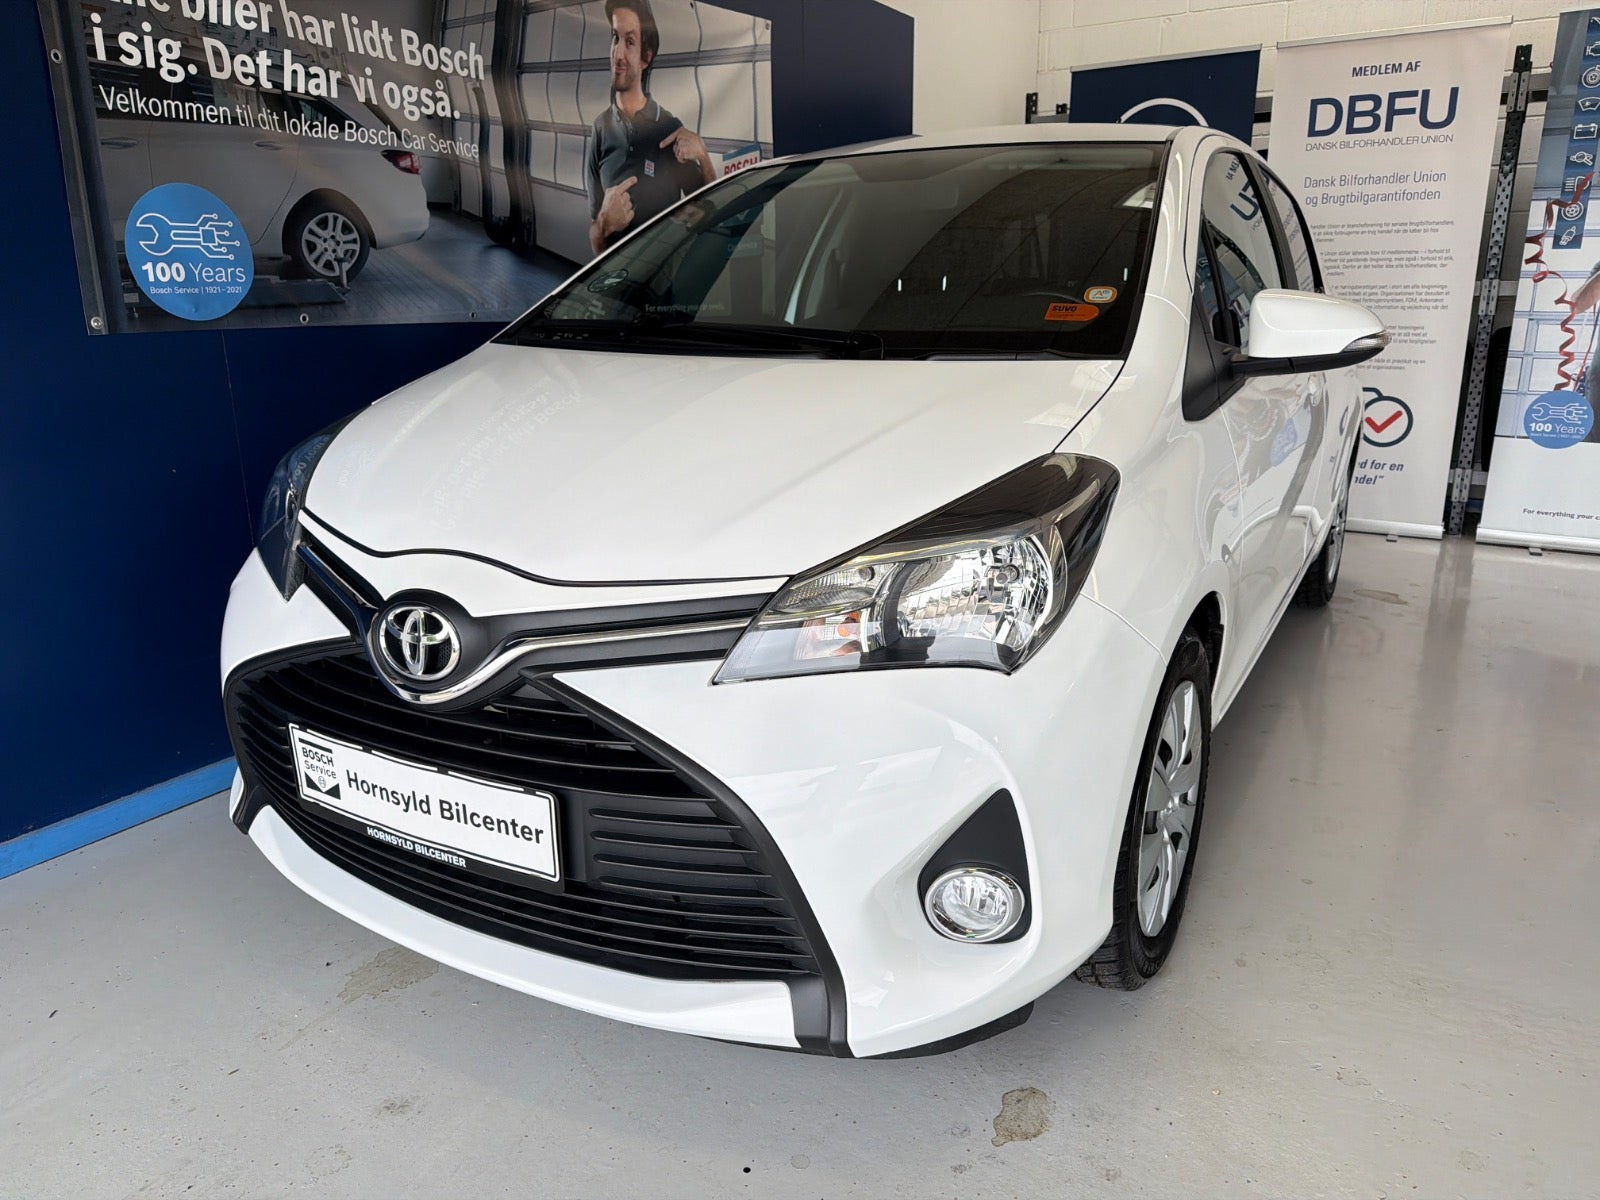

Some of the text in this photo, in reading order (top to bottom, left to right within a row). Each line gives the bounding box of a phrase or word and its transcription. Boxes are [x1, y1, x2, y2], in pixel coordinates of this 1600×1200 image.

[279, 0, 335, 48] har
[341, 13, 397, 62] lidt
[401, 28, 485, 80] Bosch
[91, 12, 460, 121] i sig. Det har vi også.
[1352, 60, 1421, 77] MEDLEM AF
[99, 84, 480, 158] Velkommen til dit lokale Bosch Car Service
[1307, 86, 1459, 138] DBFU
[1305, 134, 1454, 151] DANSK BILFORHANDLER UNION
[1304, 170, 1446, 189] Dansk Bilforhandler Union
[1305, 188, 1440, 207] og Brugtbilgarantifonden
[142, 262, 246, 282] 100 Years
[150, 286, 172, 294] Bosch
[174, 286, 199, 294] Service
[1530, 422, 1585, 434] 100 Years
[1370, 459, 1387, 470] for
[1389, 463, 1404, 471] en
[1537, 510, 1575, 519] everything
[302, 747, 334, 767] BOSCH
[304, 760, 337, 779] Service
[346, 769, 544, 844] Hornsyld Bilcenter
[367, 826, 466, 868] HORNSYLD BILCENTER
